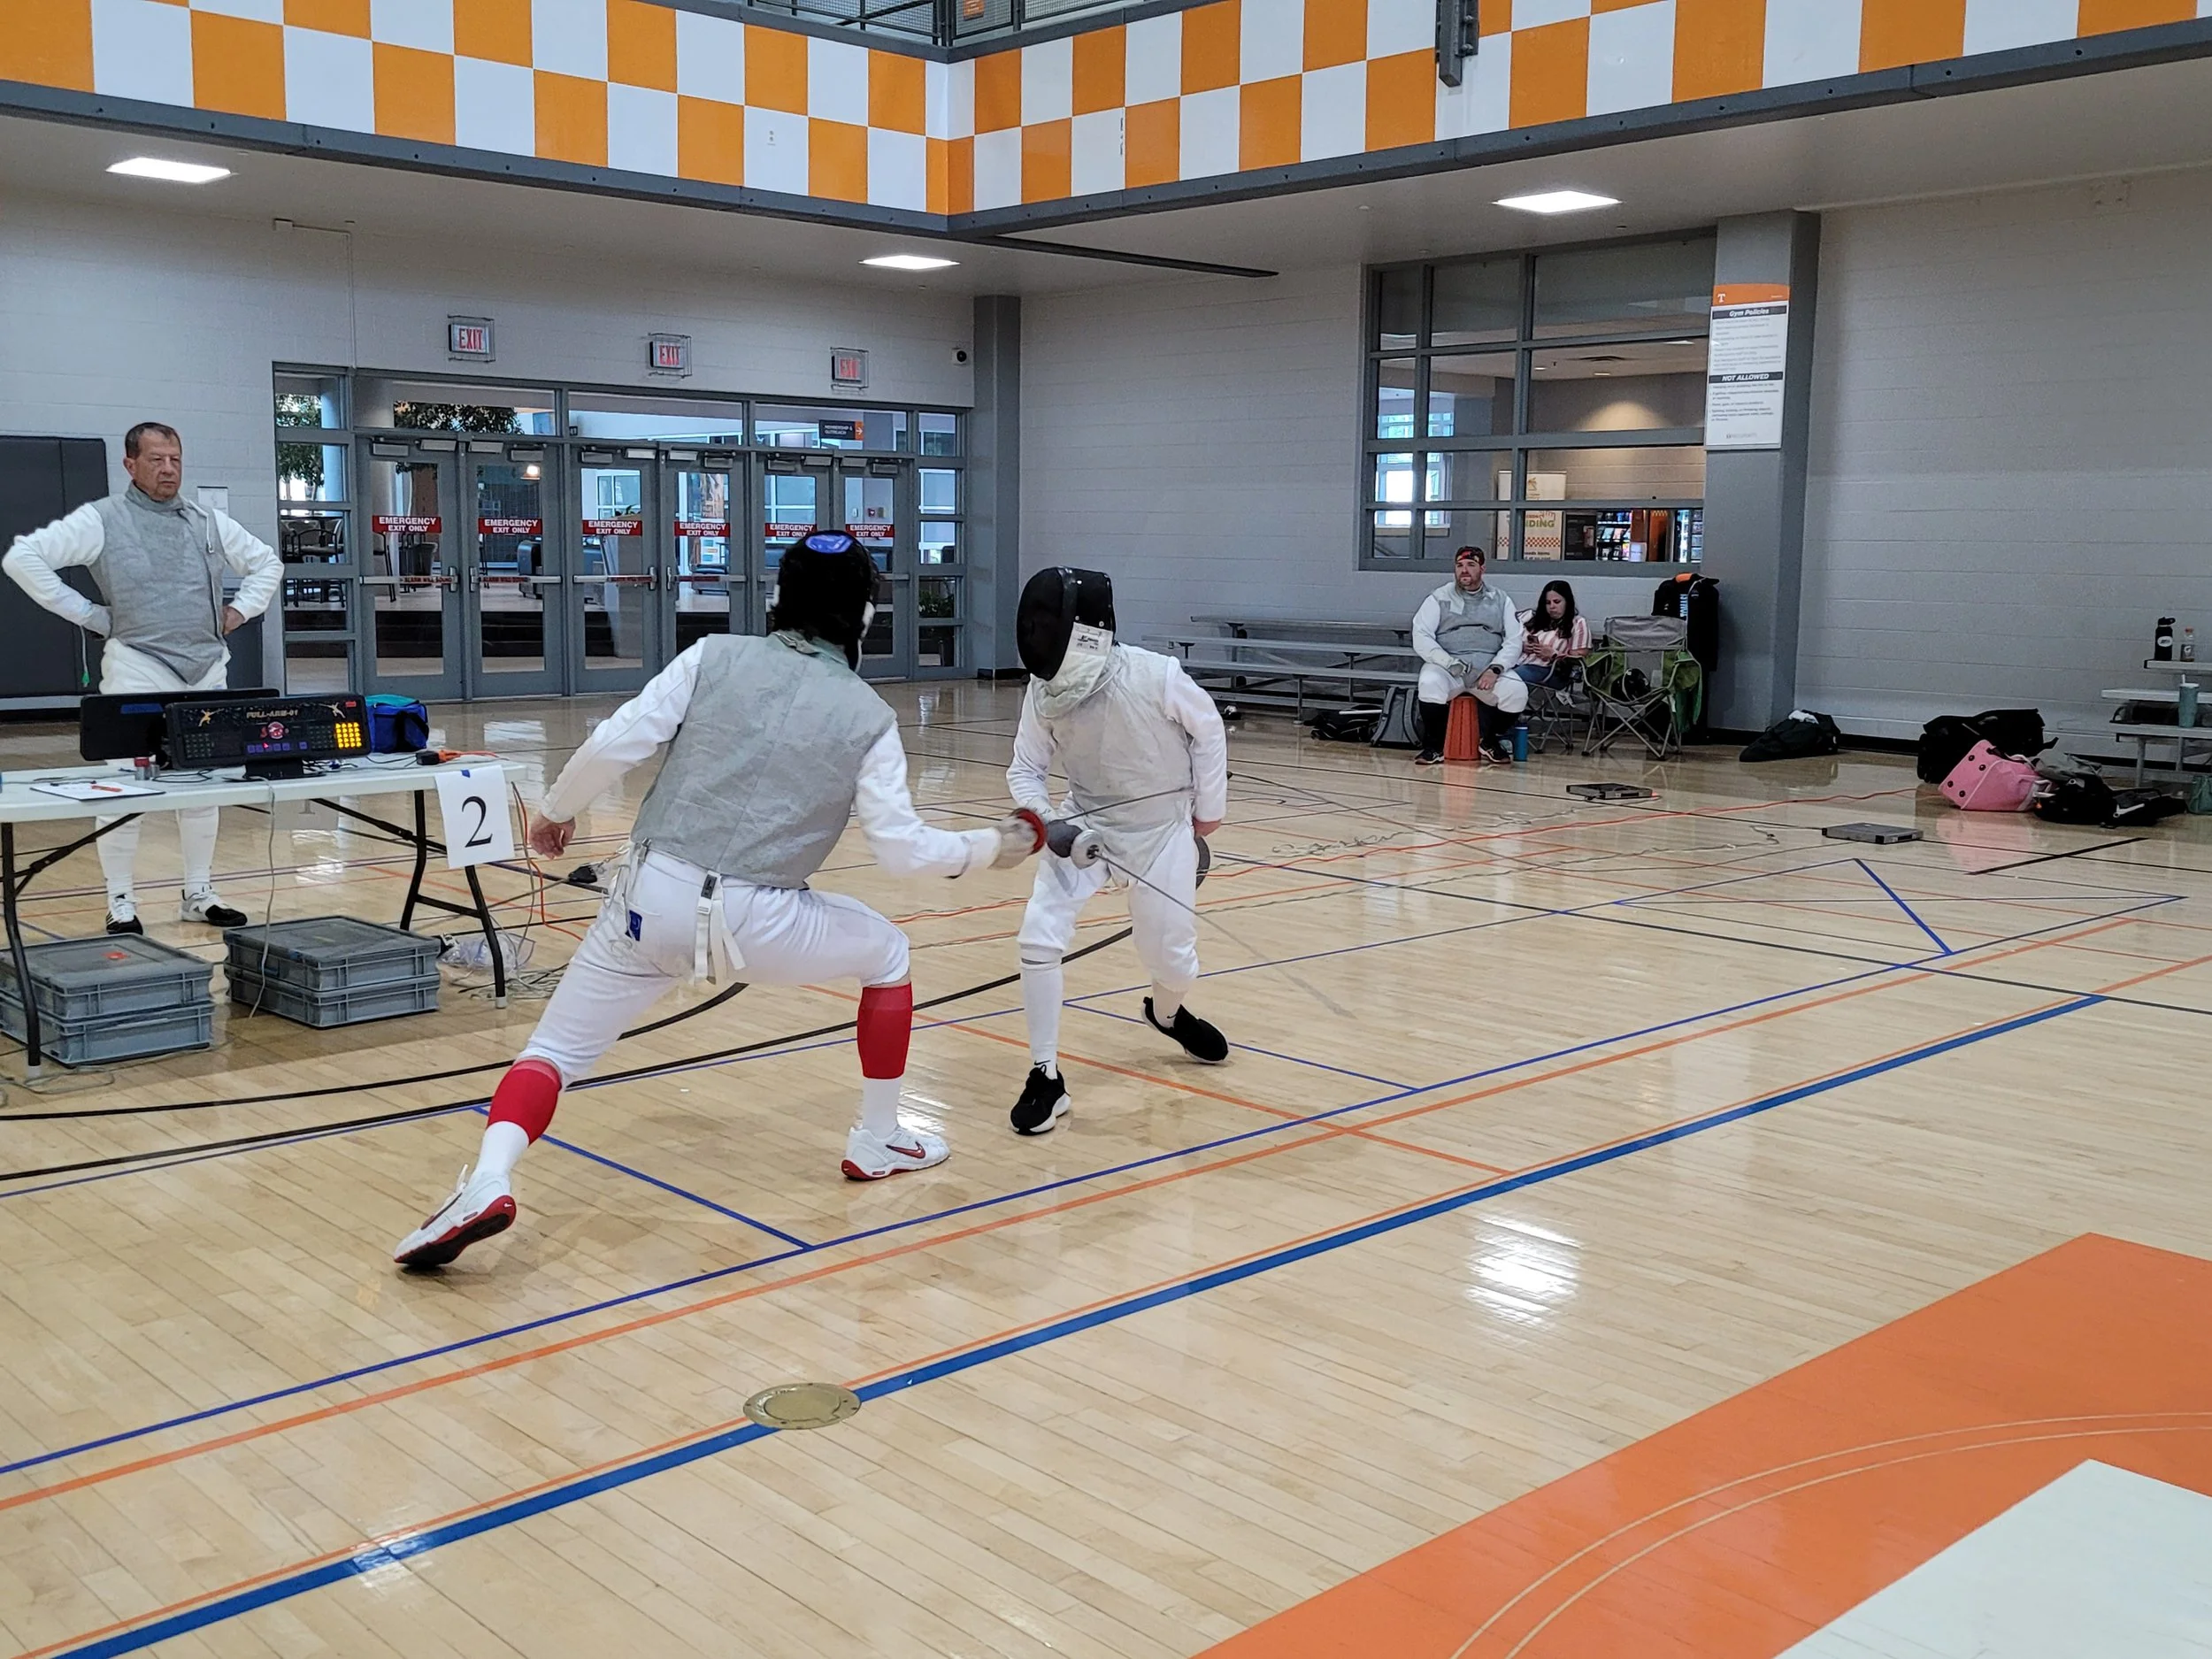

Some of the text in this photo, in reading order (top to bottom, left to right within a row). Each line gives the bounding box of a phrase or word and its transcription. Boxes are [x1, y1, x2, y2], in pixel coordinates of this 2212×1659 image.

[1717, 293, 1726, 303] T
[1729, 310, 1744, 319] Gym
[458, 327, 483, 350] EXIT
[659, 344, 680, 365] EXIT
[379, 516, 437, 526] EMERGENCY
[484, 518, 538, 527] EMERGENCY
[680, 522, 726, 531] EMERGENCY
[461, 795, 494, 849] 2
